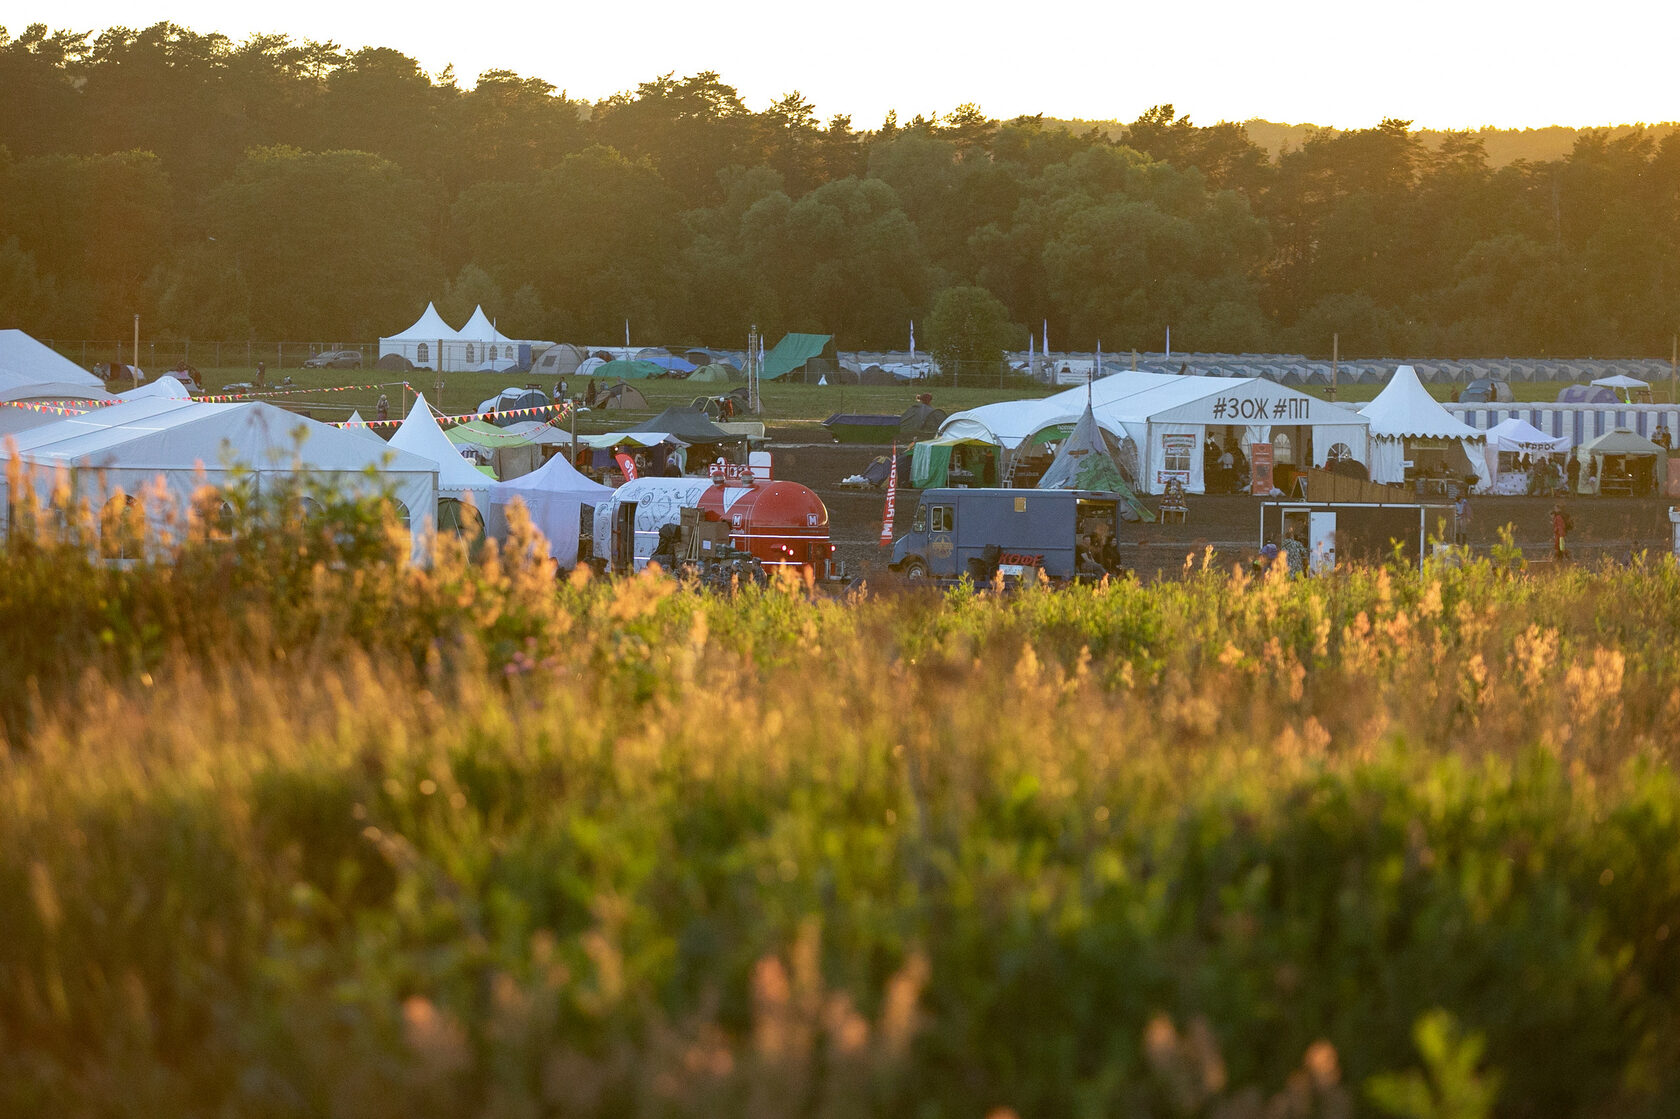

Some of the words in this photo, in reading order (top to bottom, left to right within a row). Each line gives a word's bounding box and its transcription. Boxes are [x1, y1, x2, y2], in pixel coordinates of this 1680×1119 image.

[1213, 397, 1269, 419] #ЗОЖ
[1273, 398, 1309, 419] #ПП
[998, 552, 1044, 567] КОФЕ
